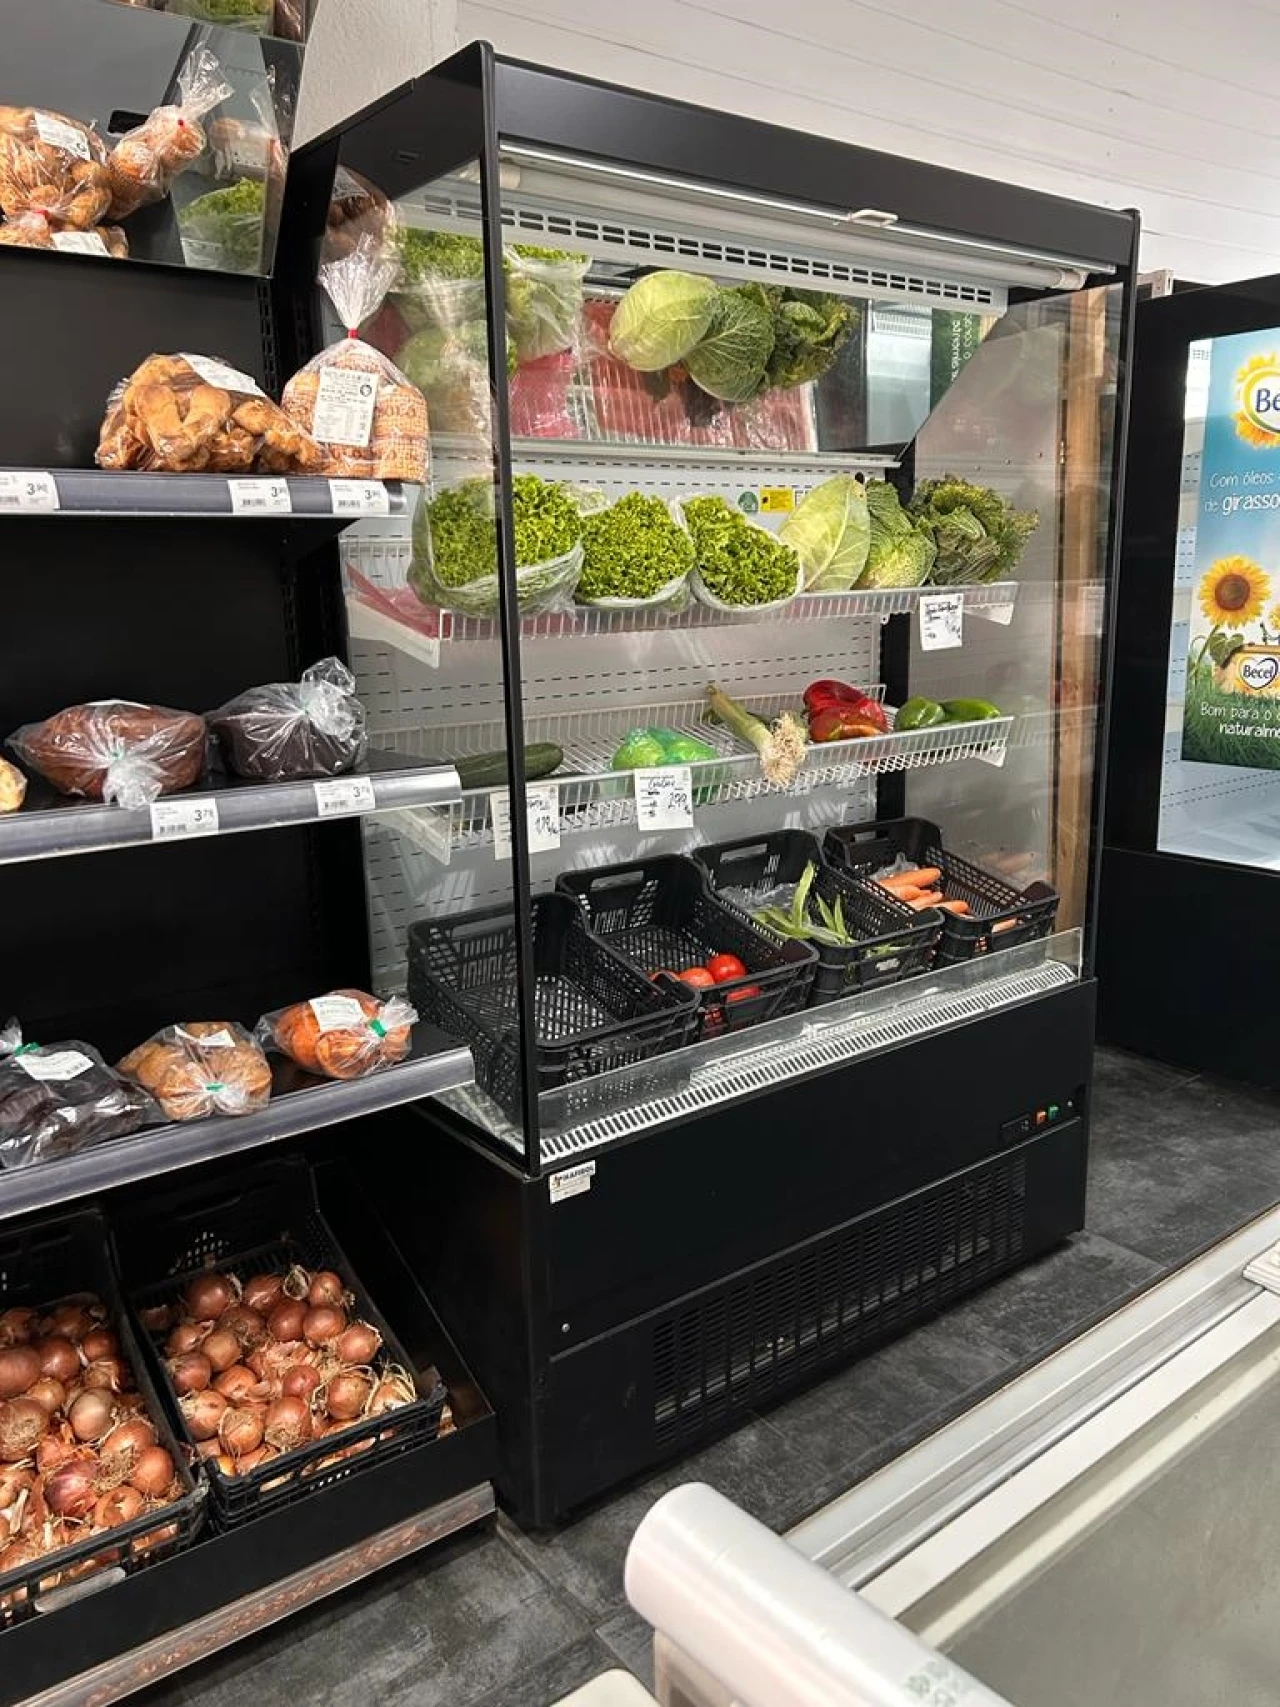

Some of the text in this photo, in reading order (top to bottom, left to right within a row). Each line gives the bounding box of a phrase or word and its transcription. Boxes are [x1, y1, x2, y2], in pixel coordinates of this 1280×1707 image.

[1210, 470, 1274, 487] Com óleos
[1222, 493, 1280, 515] girasso
[1243, 664, 1274, 679] Becel
[1200, 701, 1226, 716] Bom
[1231, 707, 1259, 720] para
[1264, 709, 1272, 721] o
